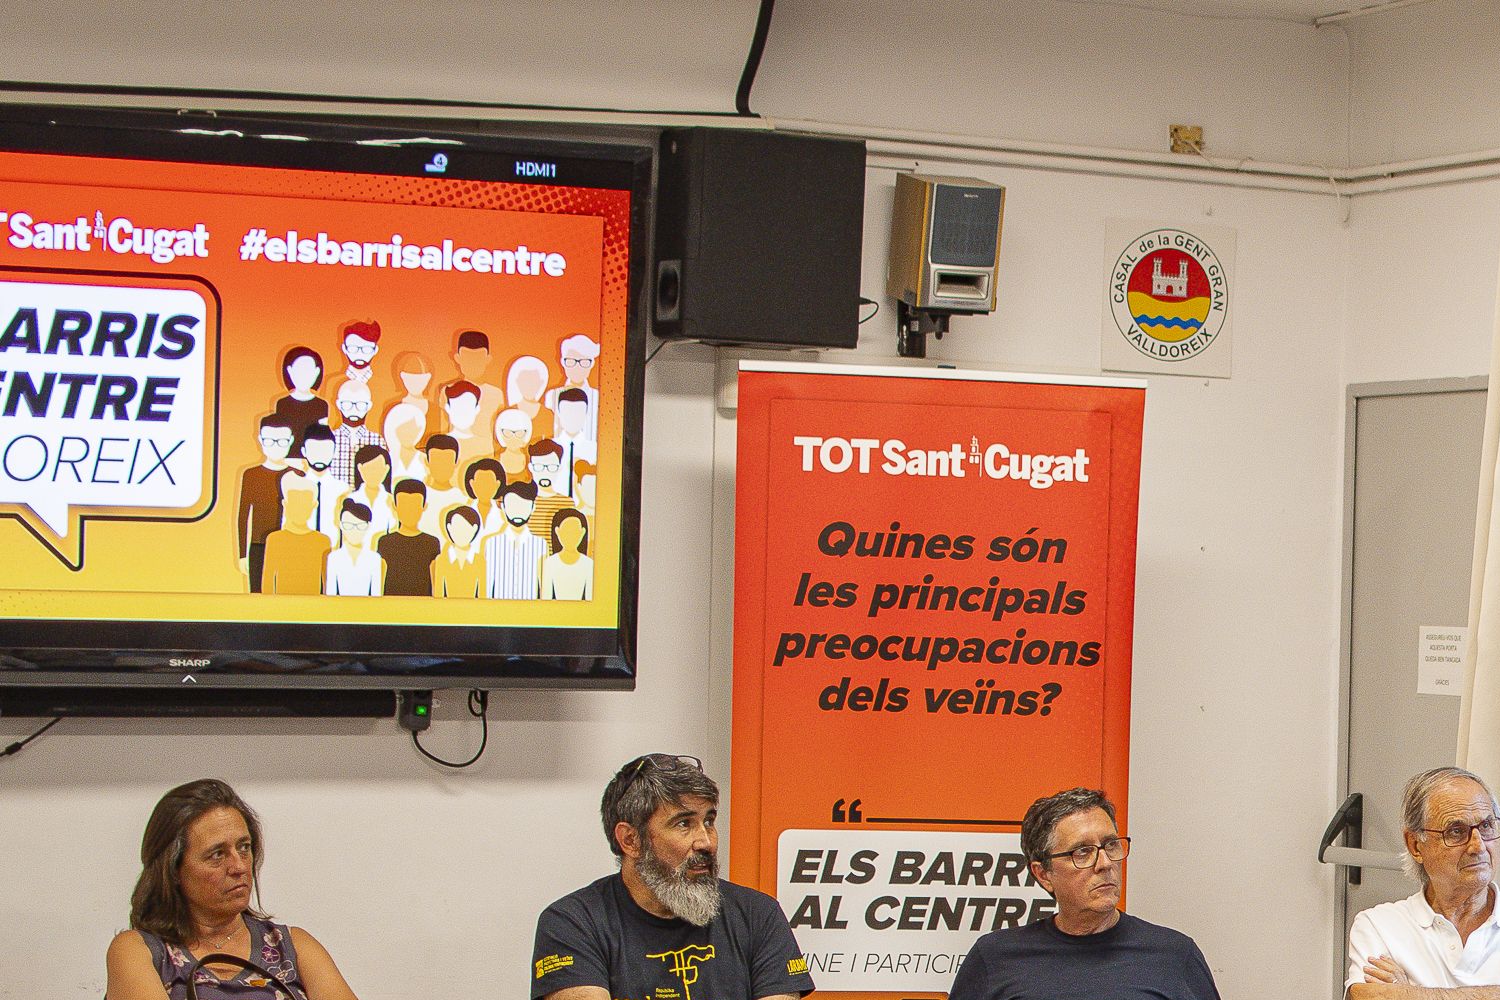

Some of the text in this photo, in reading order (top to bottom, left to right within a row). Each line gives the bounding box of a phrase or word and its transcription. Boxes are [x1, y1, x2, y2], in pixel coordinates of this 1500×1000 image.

[515, 161, 556, 177] HDMI1
[8, 212, 209, 264] Sant Cugat
[239, 228, 567, 276] #elsbarrisalcentre
[1114, 235, 1224, 312] CASAL de la GENT GRAN
[1127, 324, 1213, 358] VALLDOREIX
[0, 371, 180, 423] NTRE
[793, 436, 1090, 489] TOT Sant Cugat
[817, 521, 1068, 564] Quines són
[793, 573, 1088, 621] les principals
[169, 659, 211, 667] SHARP
[773, 628, 1102, 670] preocupacions
[818, 677, 1062, 717] dels veïns?
[789, 849, 880, 884] ELS
[789, 895, 1058, 931] AL CENTRE
[802, 953, 844, 973] INE
[850, 953, 857, 973] I
